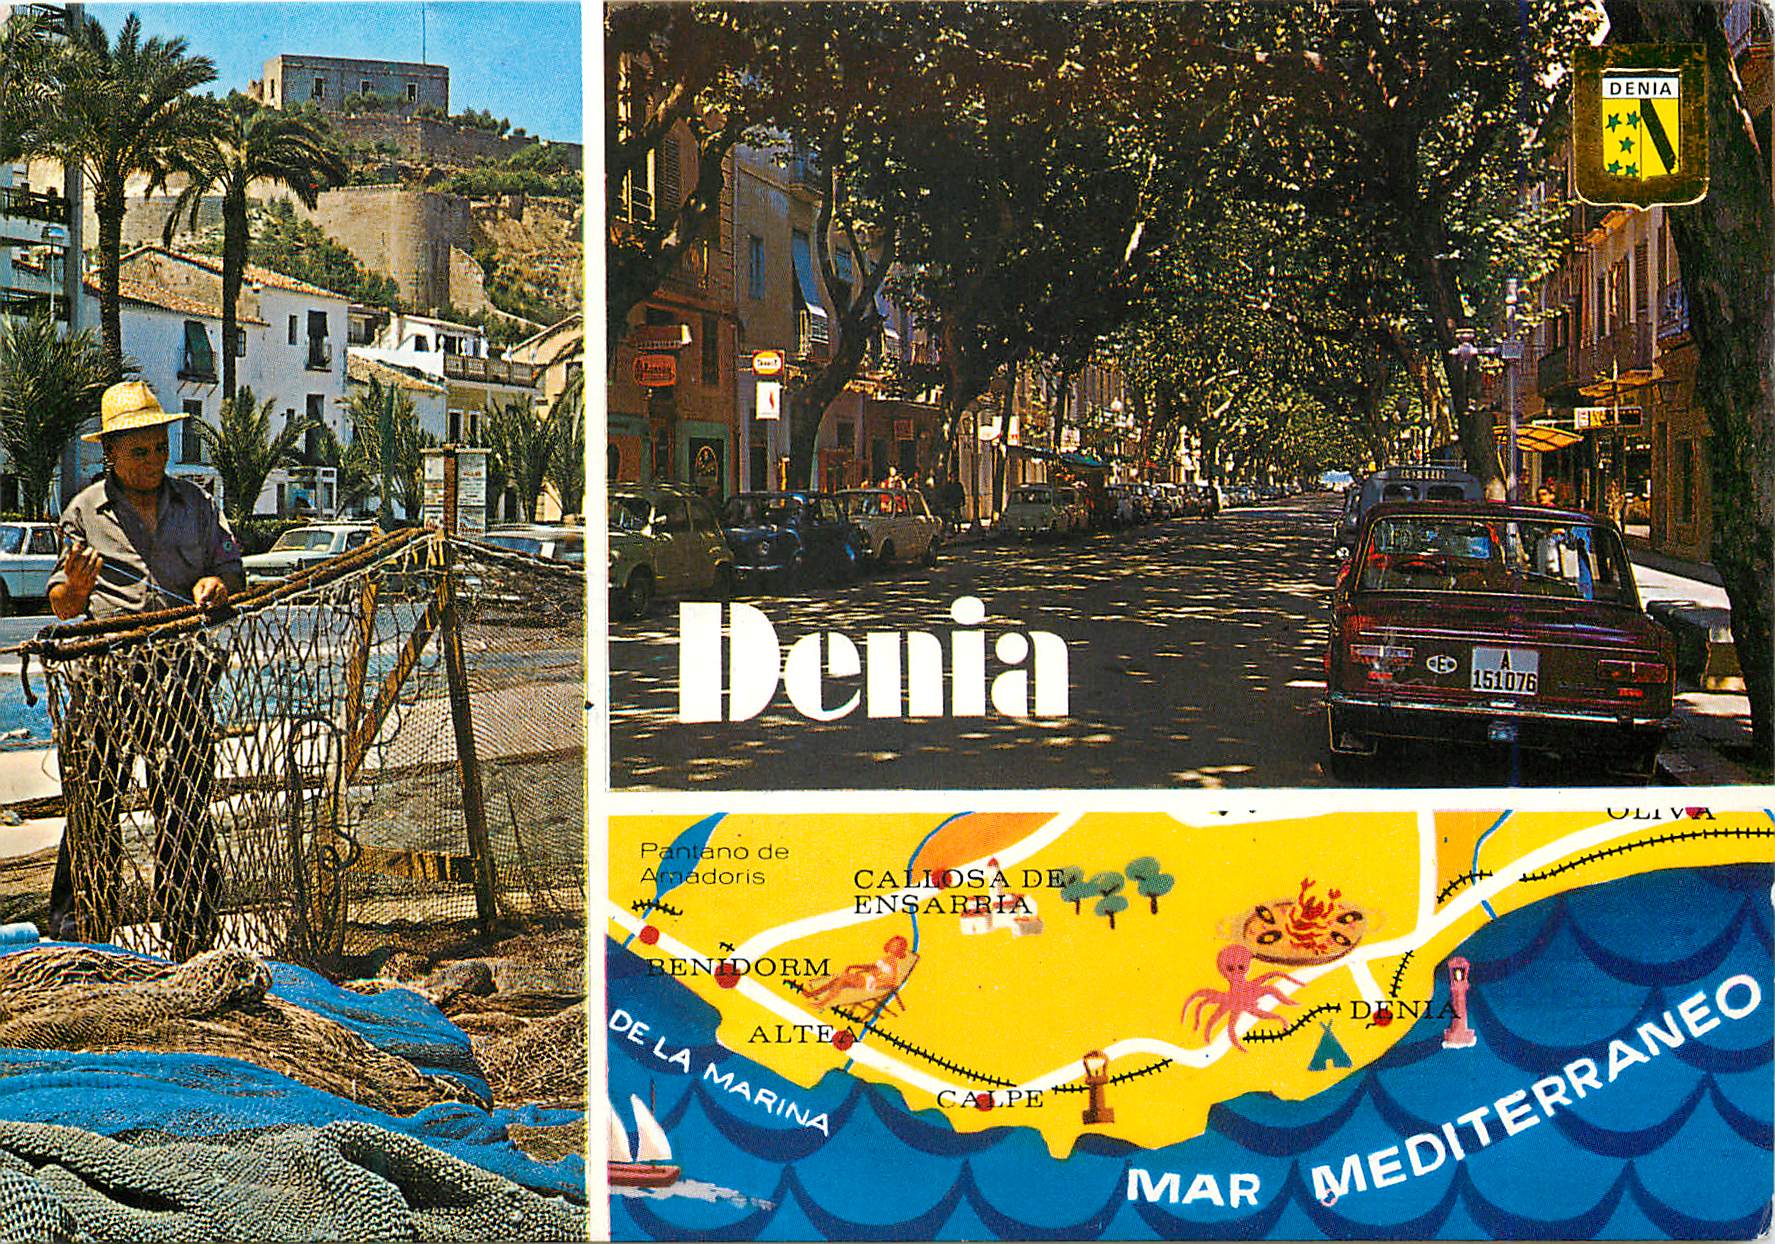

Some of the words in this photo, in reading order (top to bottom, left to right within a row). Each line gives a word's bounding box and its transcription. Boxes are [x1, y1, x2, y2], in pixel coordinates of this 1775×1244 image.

[1437, 656, 1447, 672] E
[1500, 650, 1511, 671] A
[1473, 670, 1537, 692] 151076
[641, 842, 749, 860] Pantano
[758, 843, 790, 860] de
[640, 867, 766, 885] Amadoris
[854, 869, 1012, 889] CALLOSA
[1022, 869, 1066, 888] DE
[854, 894, 1033, 914] ENSARRIA
[647, 958, 831, 977] BENIDORM
[1350, 1000, 1461, 1019] DENIA
[748, 1025, 861, 1043] ALTEA
[608, 1009, 650, 1045] DE
[653, 1036, 690, 1074] LA
[703, 1062, 829, 1137] MARINA
[937, 1090, 1044, 1108] CALPE
[1127, 1168, 1260, 1209] MAR
[1311, 974, 1762, 1202] MEDITERRANEO
